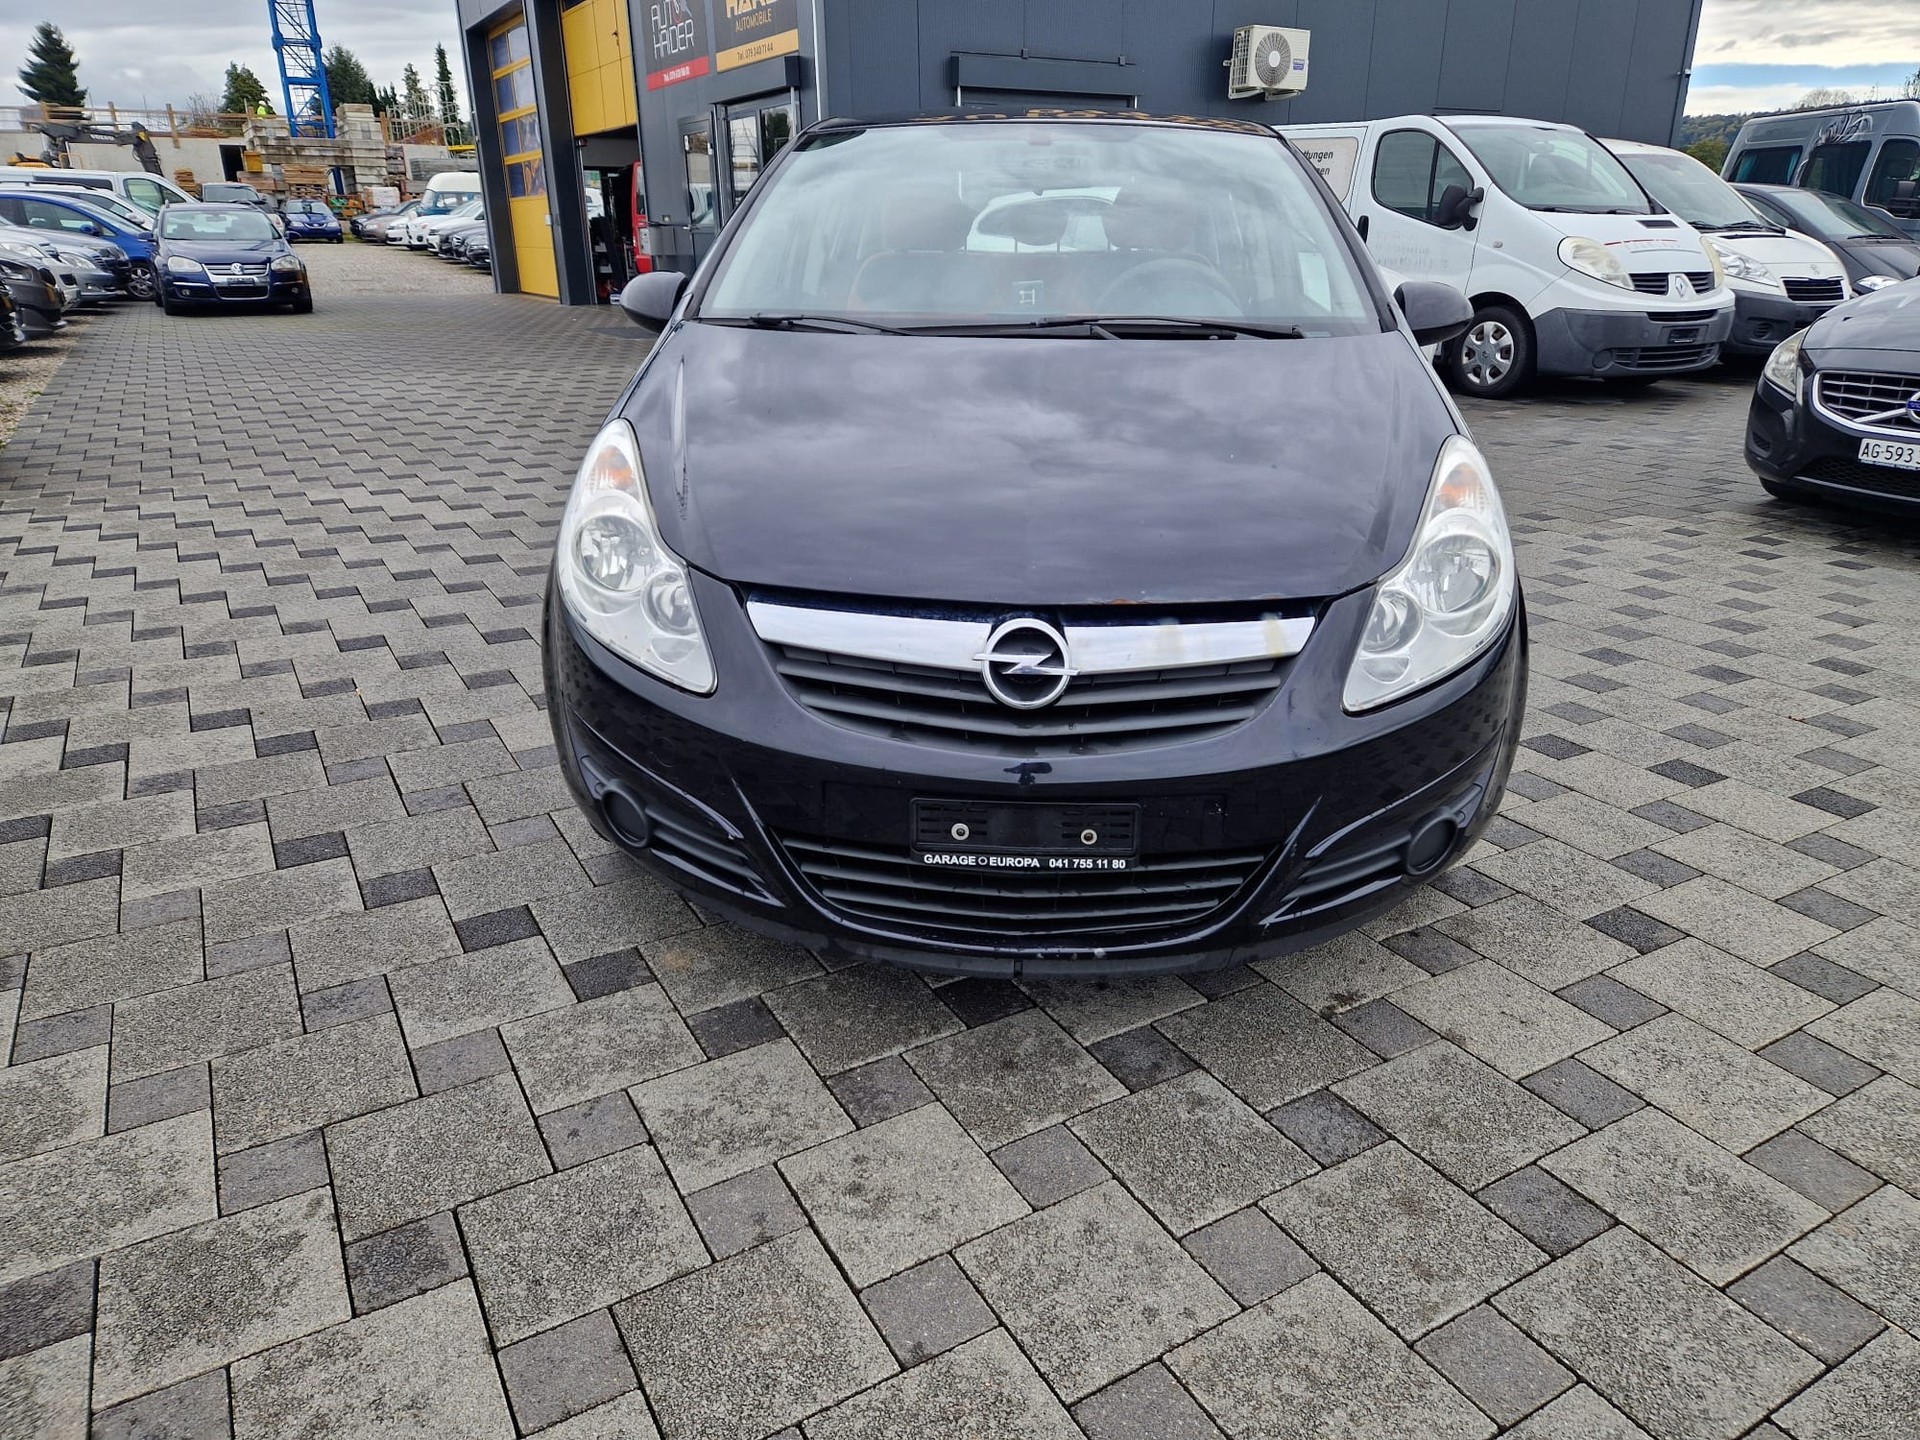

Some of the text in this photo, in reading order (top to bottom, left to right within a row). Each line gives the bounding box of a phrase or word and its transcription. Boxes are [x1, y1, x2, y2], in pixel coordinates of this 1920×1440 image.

[736, 8, 772, 32] AUTOMOBILE
[653, 18, 695, 60] HAIDER
[923, 854, 1126, 869] GARAGE EUROPA 041 755 11 80
